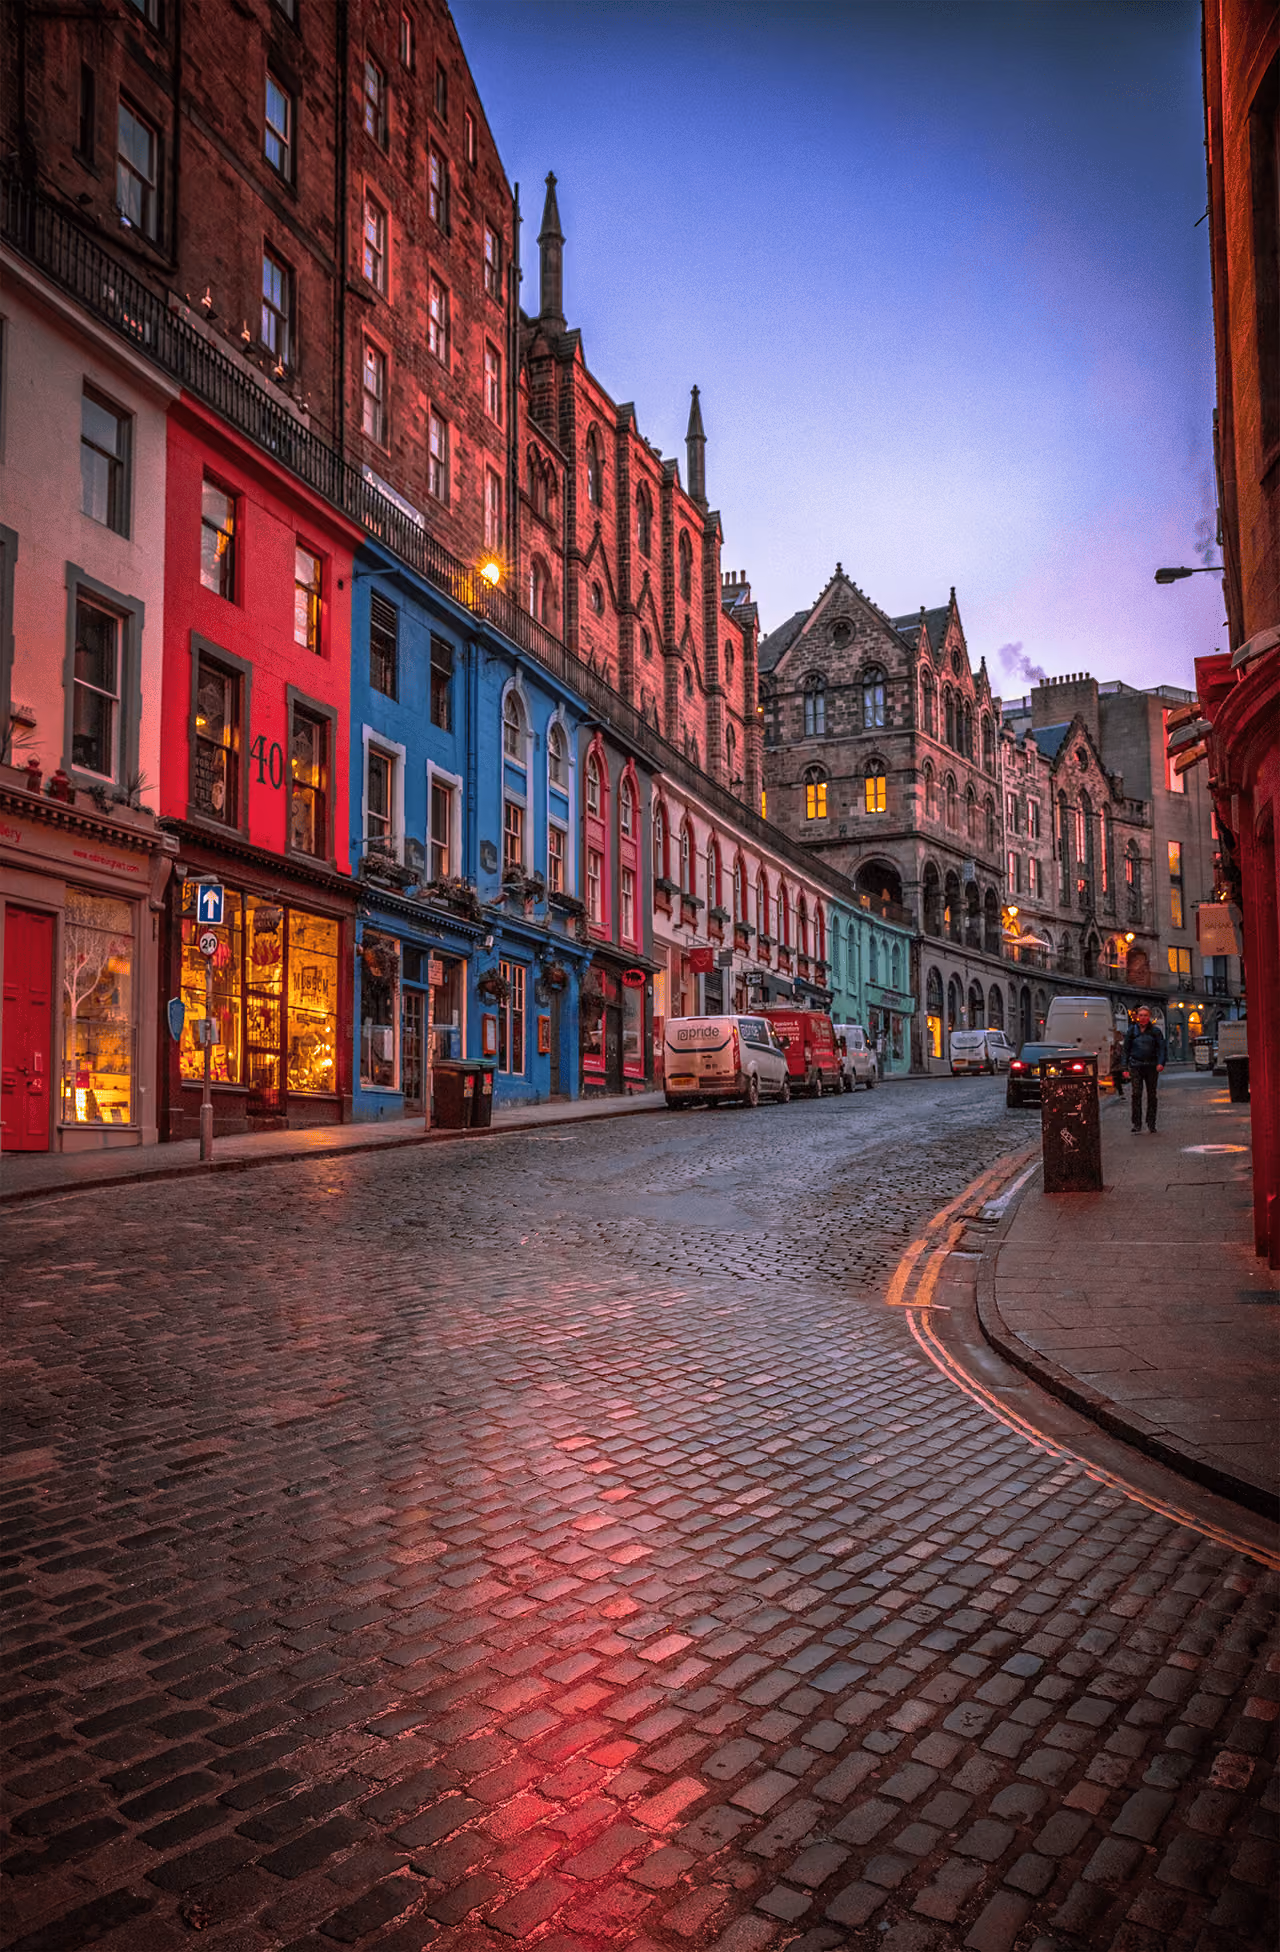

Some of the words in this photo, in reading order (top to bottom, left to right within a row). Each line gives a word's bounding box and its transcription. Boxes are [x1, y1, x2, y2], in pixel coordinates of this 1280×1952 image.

[250, 735, 283, 790] 40
[201, 938, 218, 949] 20
[689, 1026, 720, 1041] pride
